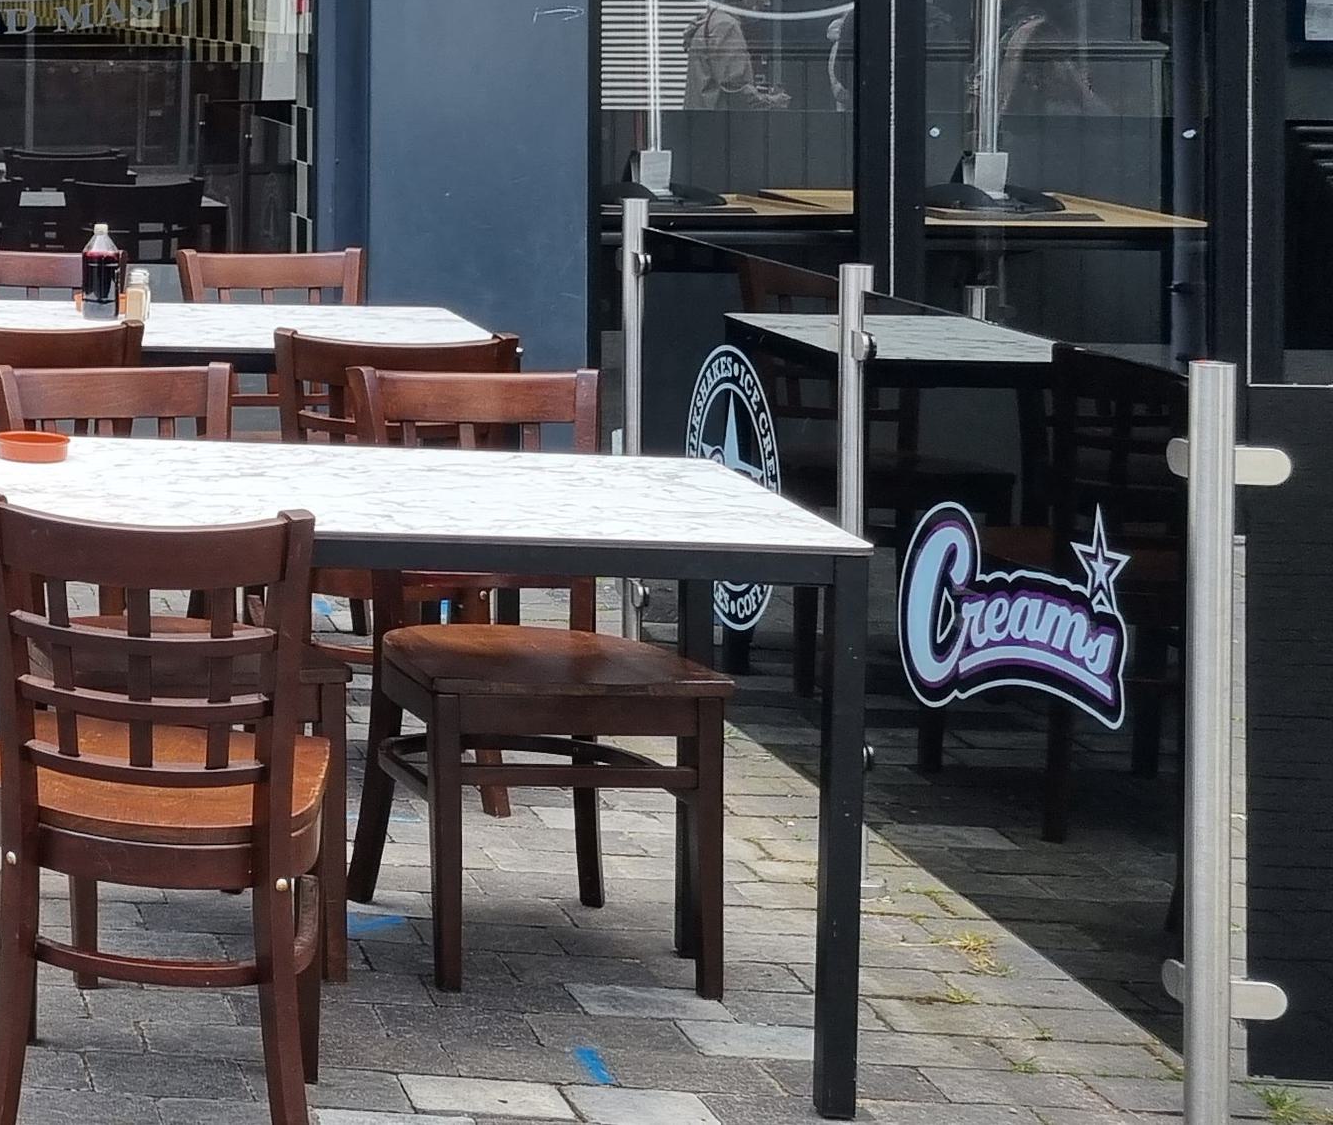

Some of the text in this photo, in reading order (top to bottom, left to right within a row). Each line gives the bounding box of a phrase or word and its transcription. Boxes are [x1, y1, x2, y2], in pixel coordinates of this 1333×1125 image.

[688, 356, 733, 458] ILKSHAKES
[738, 363, 761, 412] ICE
[906, 525, 1116, 684] Creams
